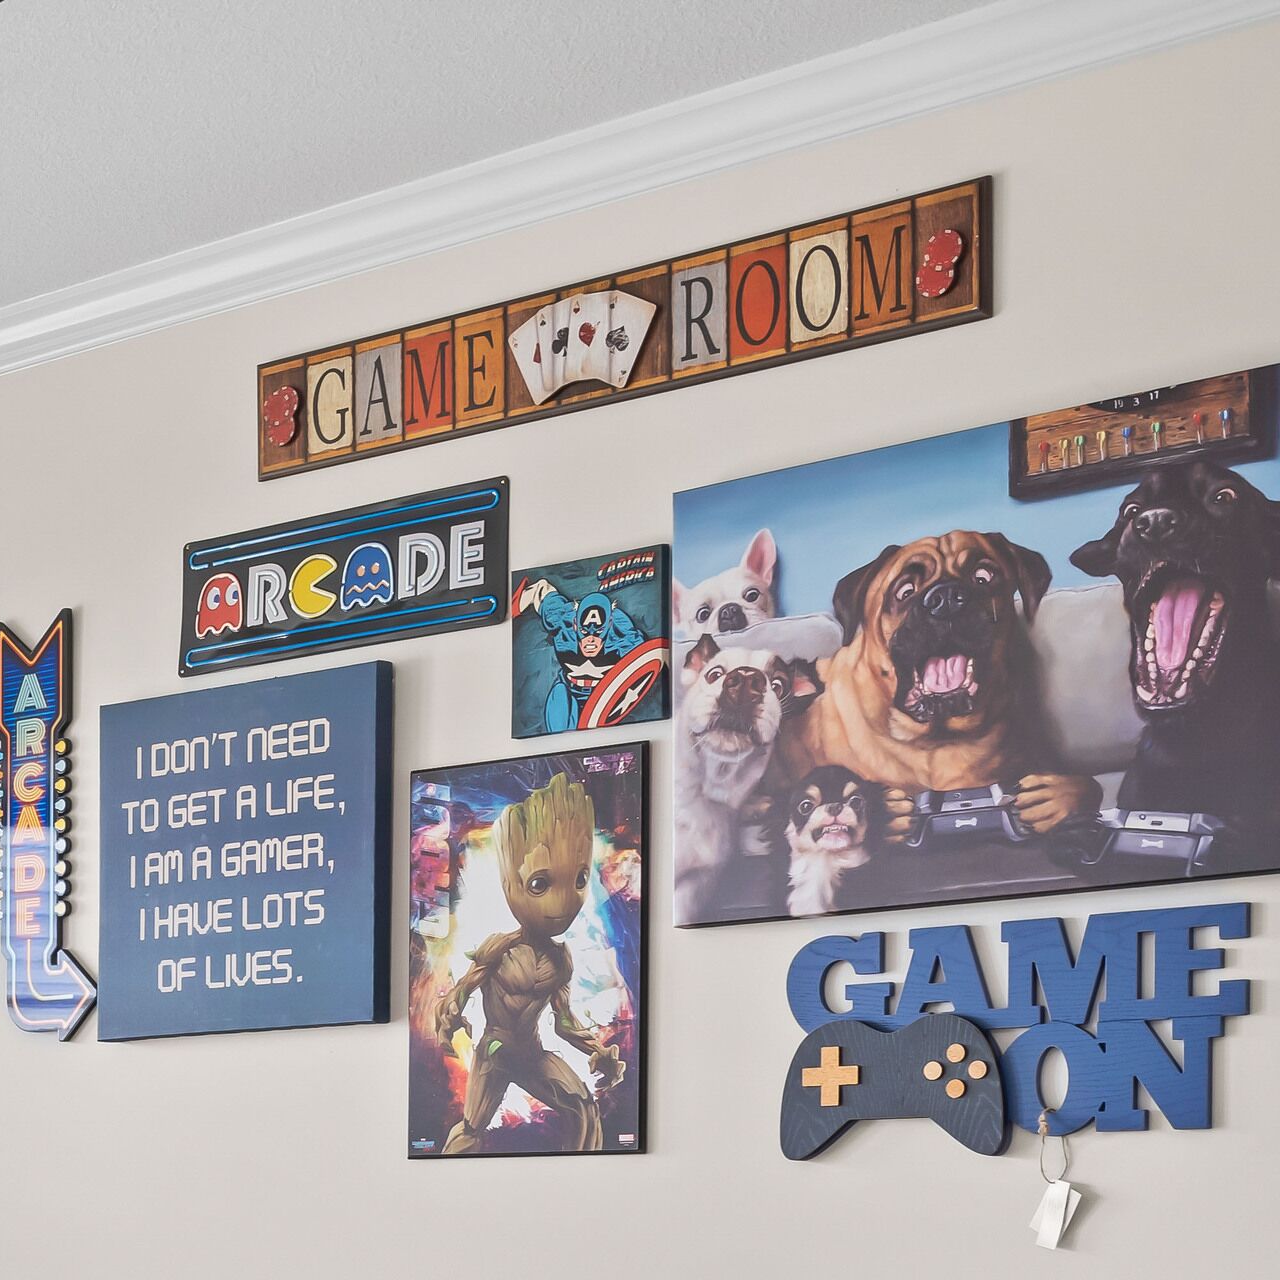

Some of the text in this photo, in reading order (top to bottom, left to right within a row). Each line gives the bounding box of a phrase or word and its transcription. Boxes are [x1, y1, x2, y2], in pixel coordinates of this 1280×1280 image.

[313, 224, 907, 445] GAME ROOM
[195, 520, 486, 640] ARCADE
[583, 609, 602, 626] A
[136, 717, 330, 780] I DON'T NEED
[12, 672, 48, 936] ARCADE
[121, 773, 345, 835] TO GET A LIFE,
[130, 832, 335, 889] I AM A GAMER,
[140, 889, 325, 941] I HAVE LOTS
[157, 948, 303, 993] OF LIVES.
[786, 902, 1252, 1033] GAME
[1000, 1015, 1225, 1136] ON
